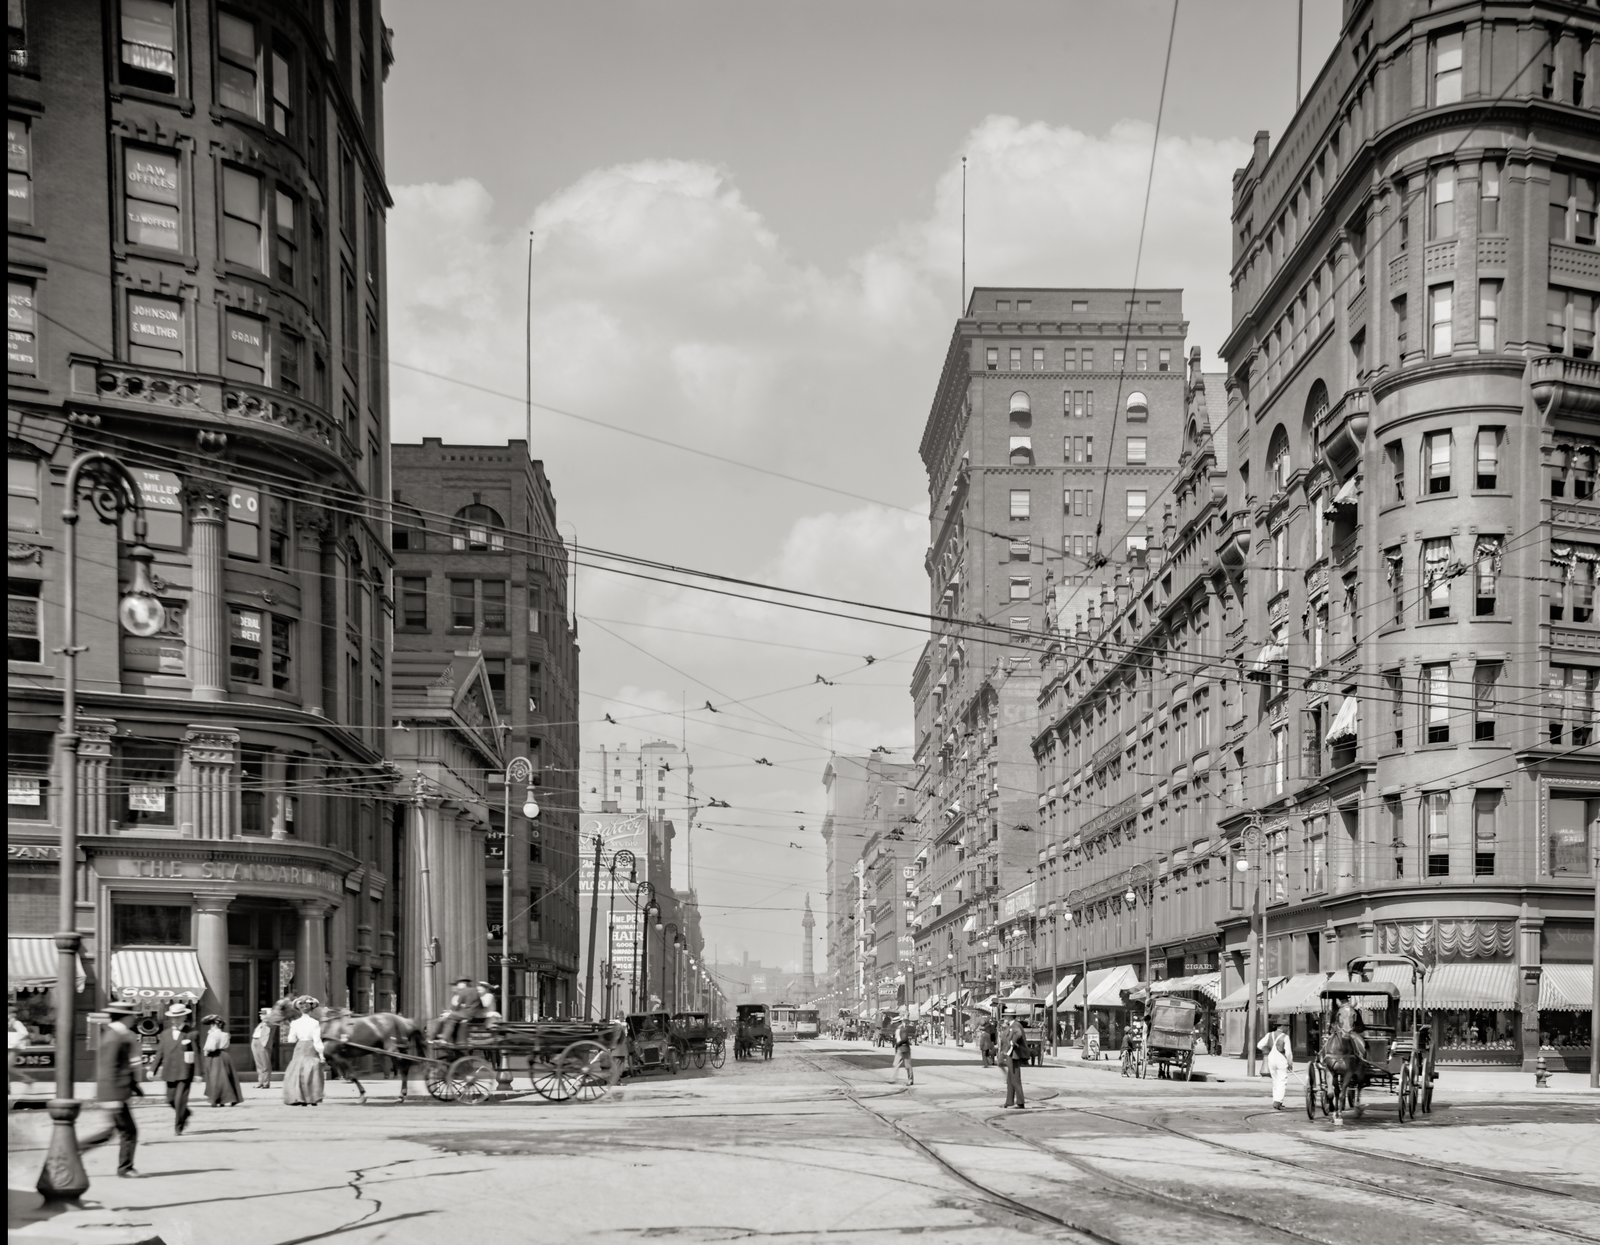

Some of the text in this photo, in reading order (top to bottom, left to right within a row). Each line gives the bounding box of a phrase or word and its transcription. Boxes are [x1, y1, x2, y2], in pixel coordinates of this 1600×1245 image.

[136, 162, 165, 176] LAW
[129, 172, 176, 189] OFFICES
[132, 305, 178, 321] JOHNSON
[132, 322, 178, 339] & WALTHER
[231, 330, 259, 347] GRAIN
[143, 472, 160, 481] THE
[160, 496, 175, 505] CO.
[231, 615, 261, 630] FEDERAL
[231, 630, 261, 643] SURETY
[610, 839, 638, 847] STUDIO
[135, 860, 183, 878] THE
[201, 861, 309, 886] STANDARD
[612, 931, 643, 941] HAIR
[1555, 927, 1592, 945] Selzer's
[122, 987, 198, 998] SODA
